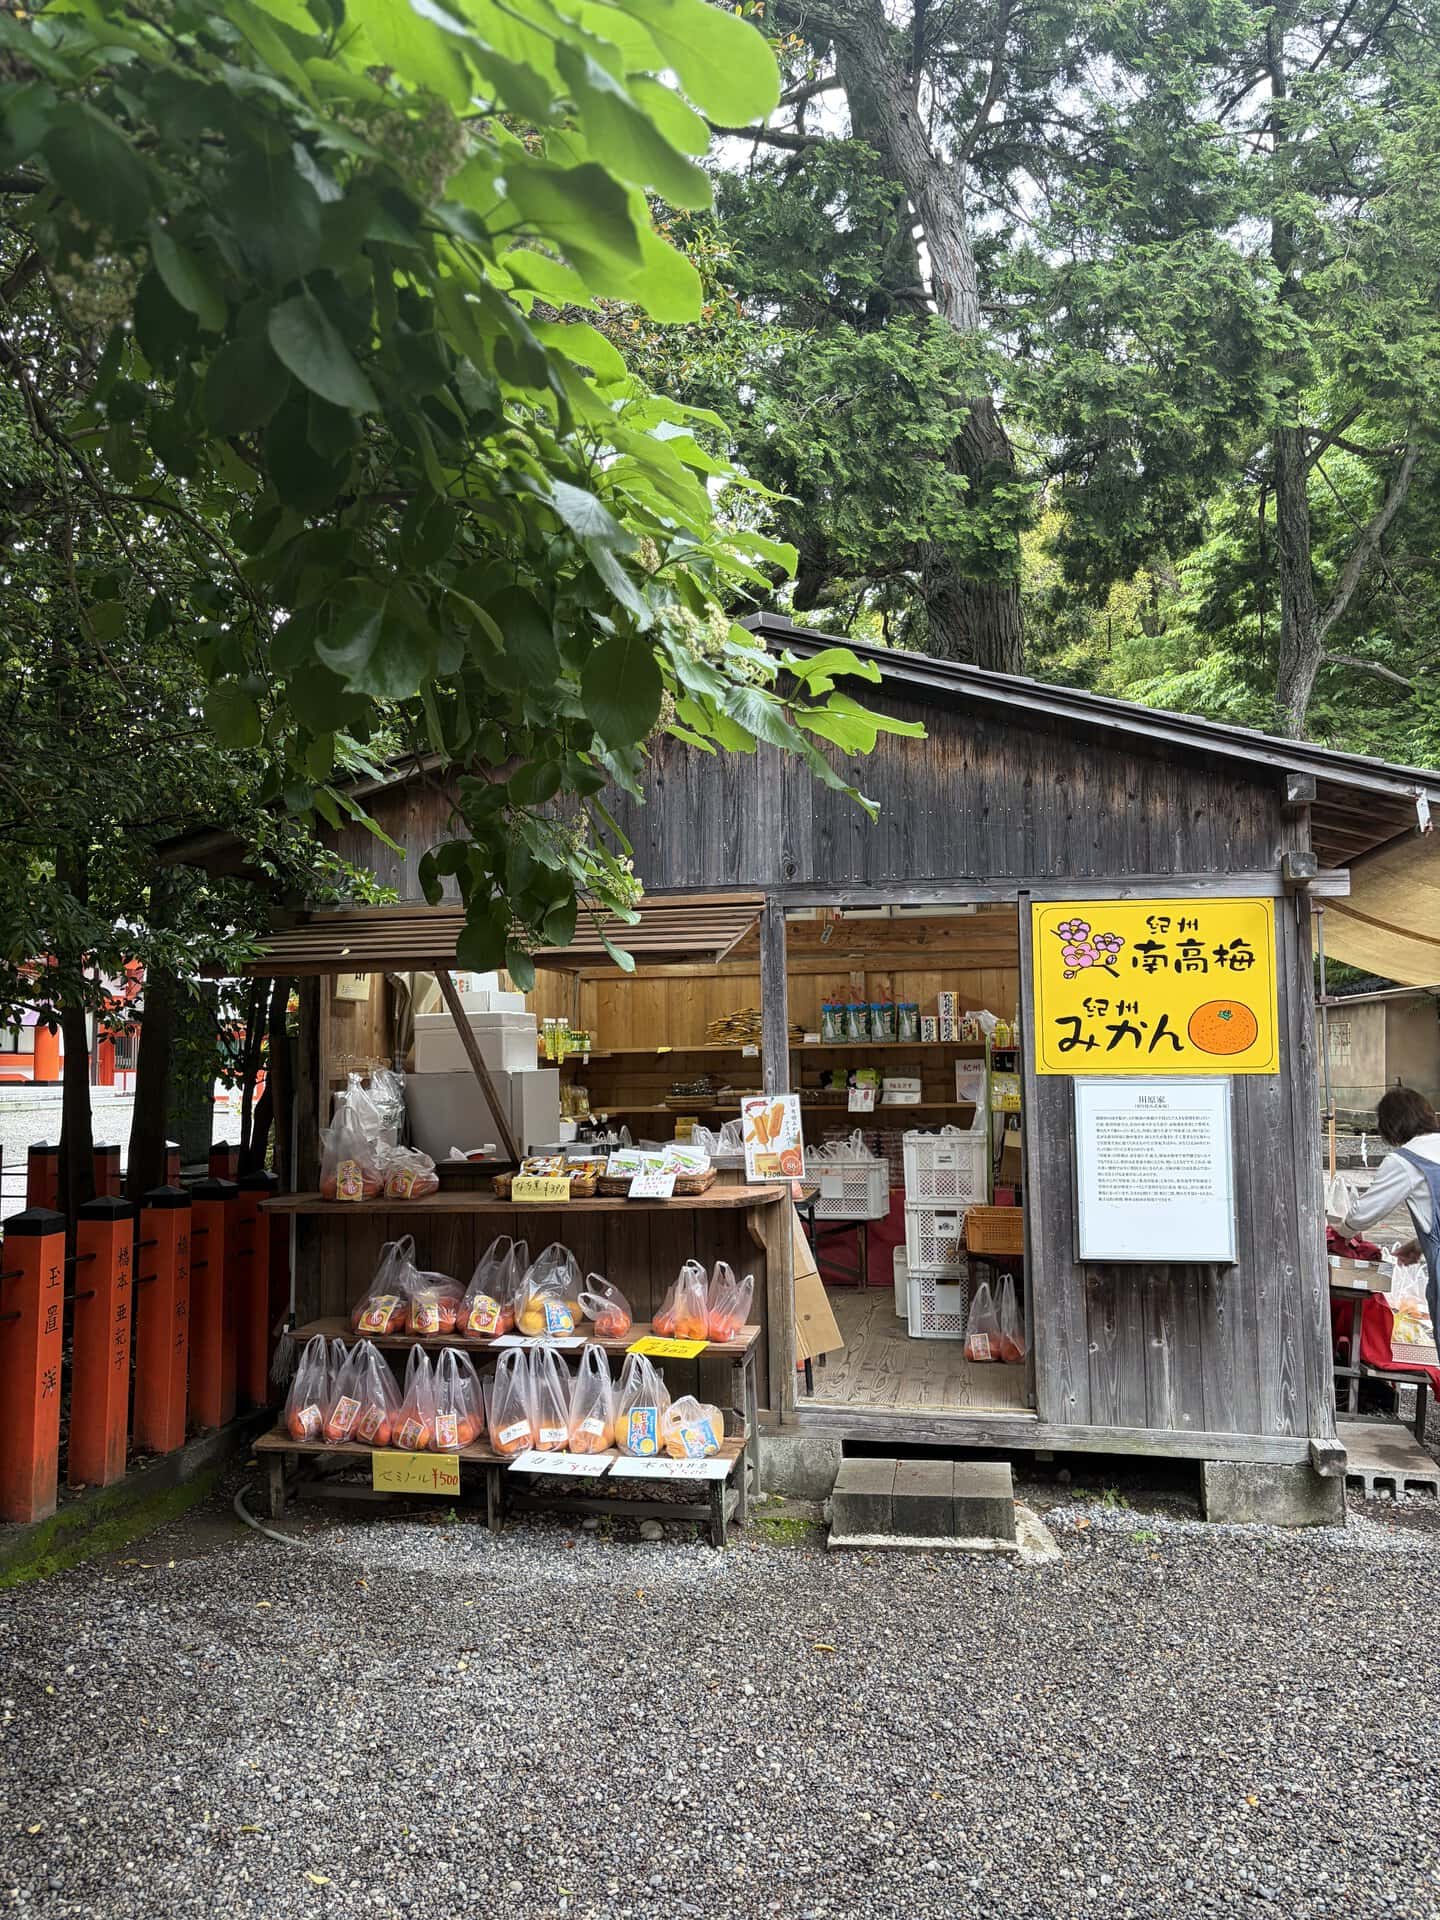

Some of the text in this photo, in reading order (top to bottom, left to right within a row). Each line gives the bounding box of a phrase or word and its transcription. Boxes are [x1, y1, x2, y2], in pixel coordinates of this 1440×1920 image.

[1146, 915, 1199, 934] 紀州
[1131, 938, 1256, 975] 南高梅
[1082, 997, 1139, 1017] 紀州
[1055, 1014, 1185, 1054] みかん
[432, 1467, 458, 1489] ¥500
